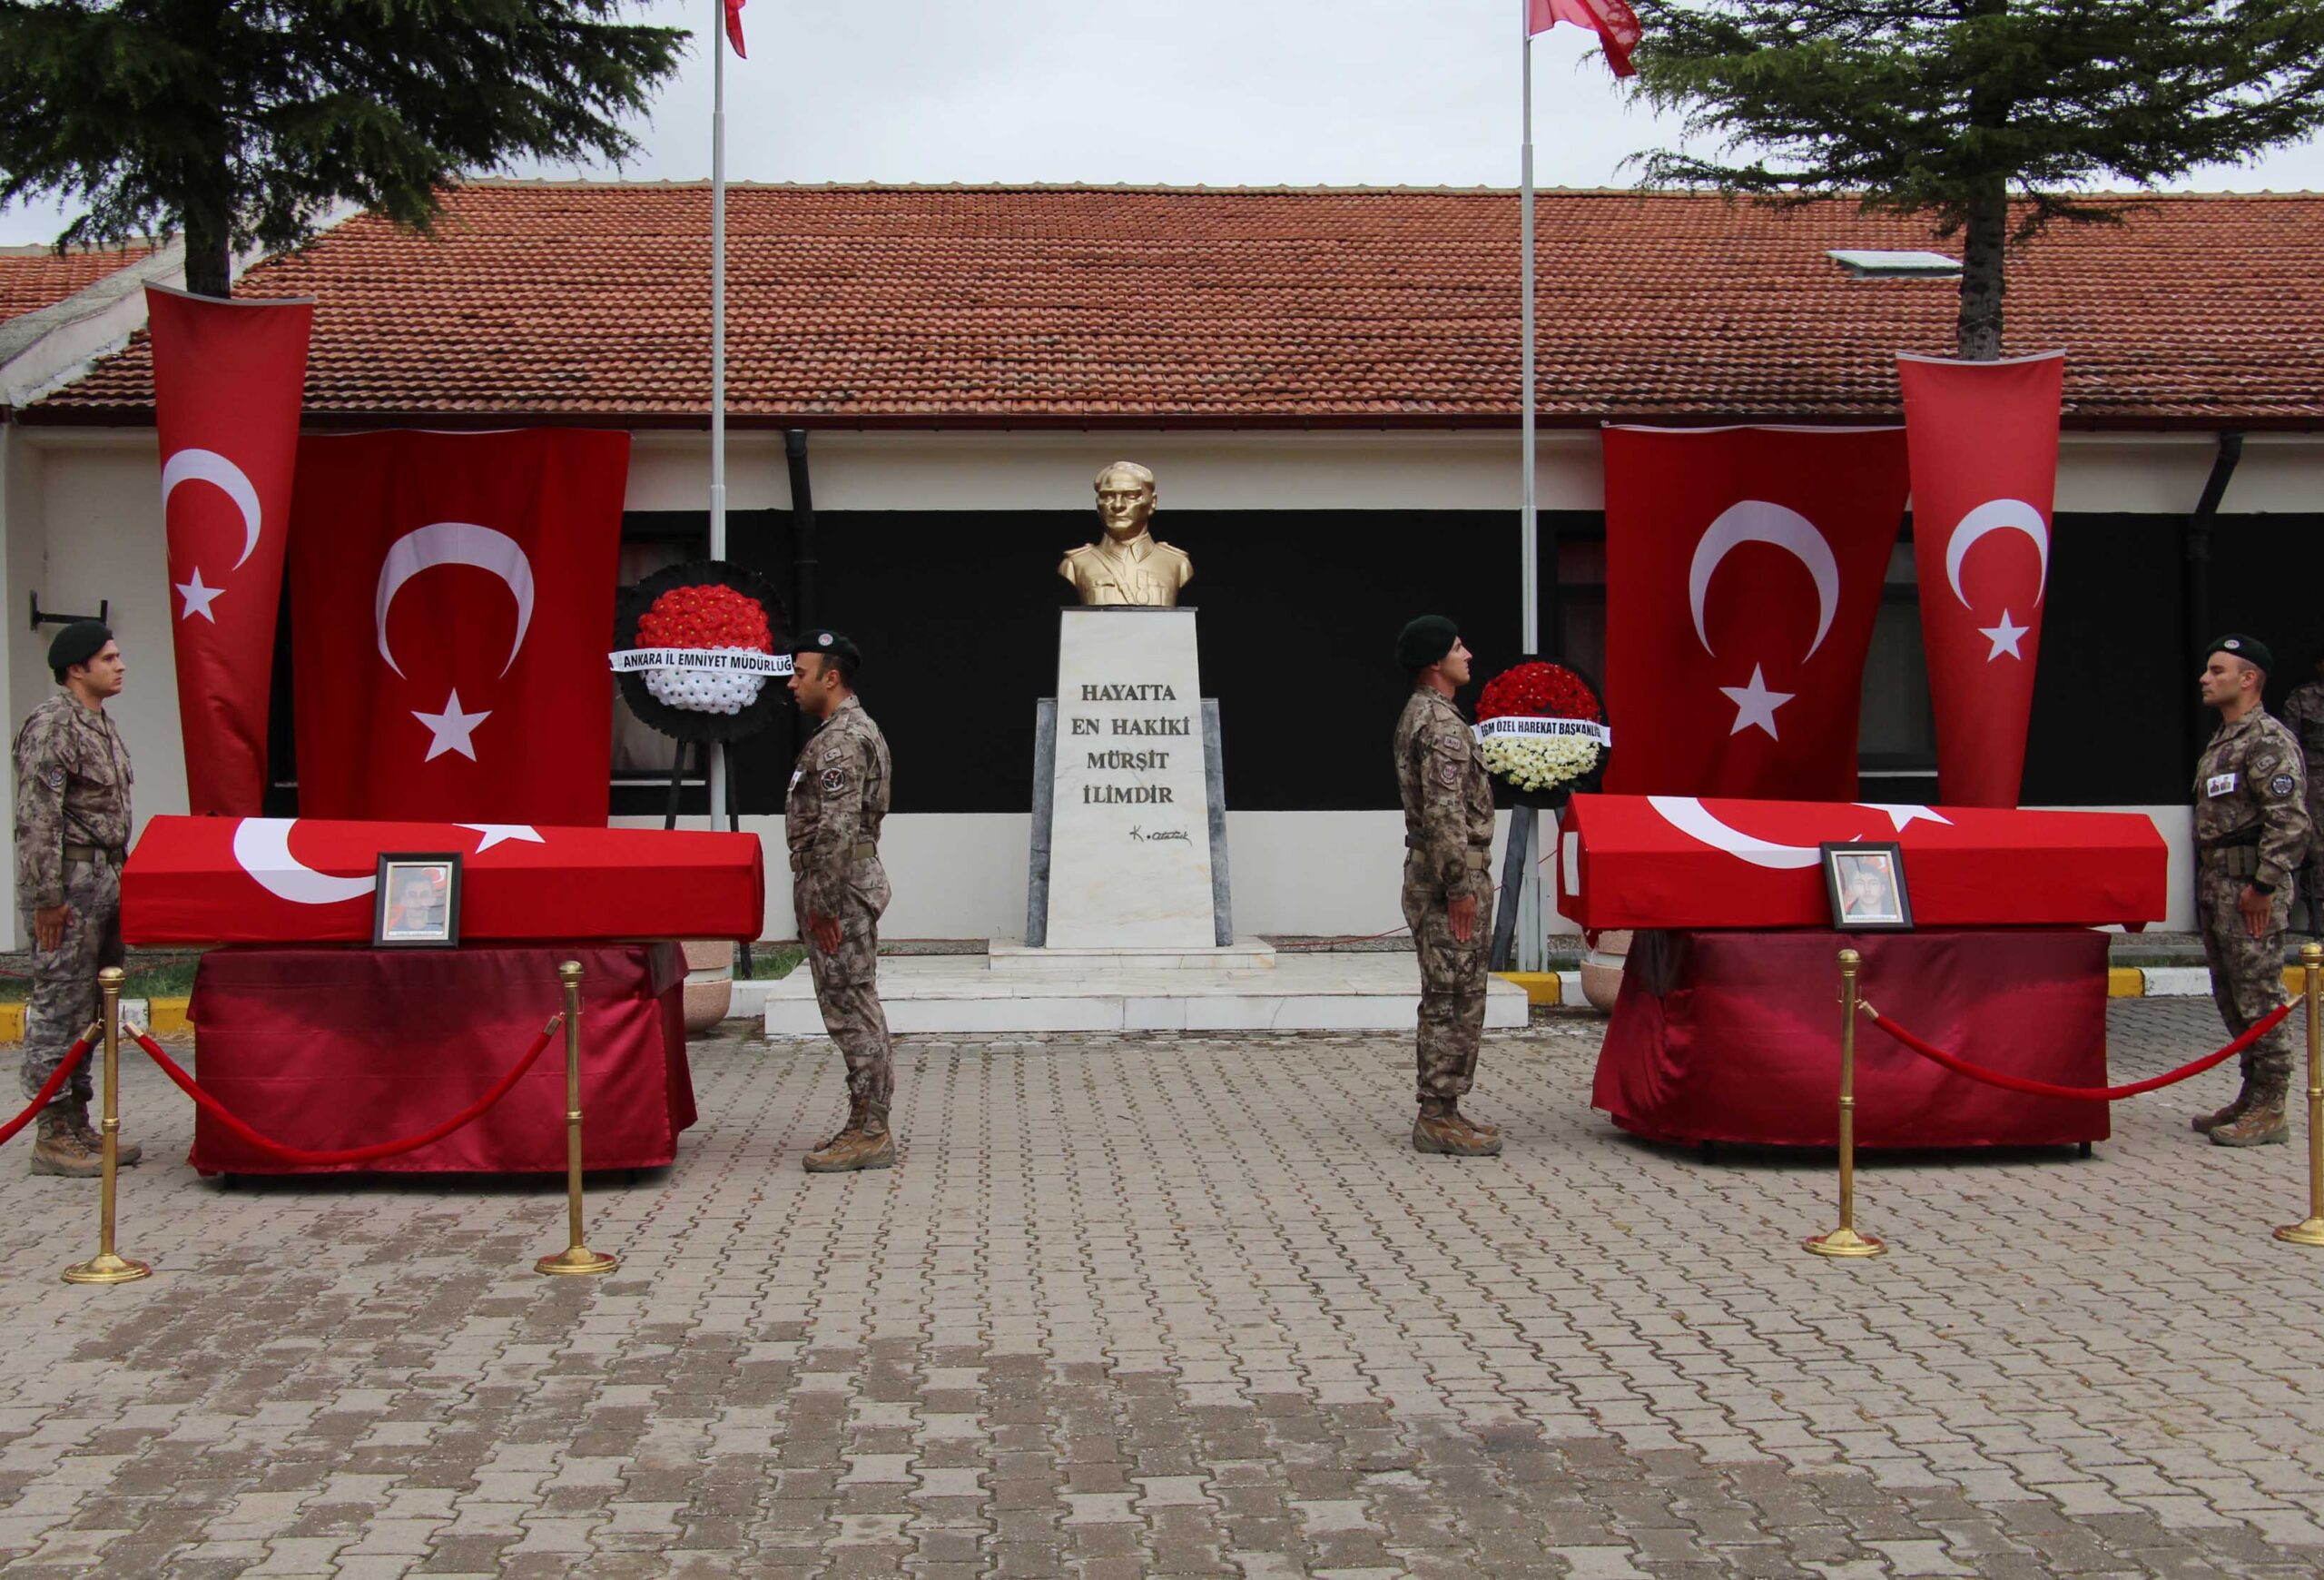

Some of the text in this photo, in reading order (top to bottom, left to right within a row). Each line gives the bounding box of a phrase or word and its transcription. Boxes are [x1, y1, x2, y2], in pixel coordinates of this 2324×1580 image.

[624, 649, 793, 672] ANKARA İL EMNİYET MÜDÜRLÜĞ
[1081, 684, 1177, 701] HAYATTA
[1071, 716, 1191, 736] EN HAKİKİ
[1481, 722, 1495, 737] EGM
[1496, 718, 1516, 733] ÖZEL
[1518, 721, 1557, 735] HAREKAT
[1087, 749, 1169, 772] MÜRŞİT
[1083, 784, 1174, 804] İLİMDİR
